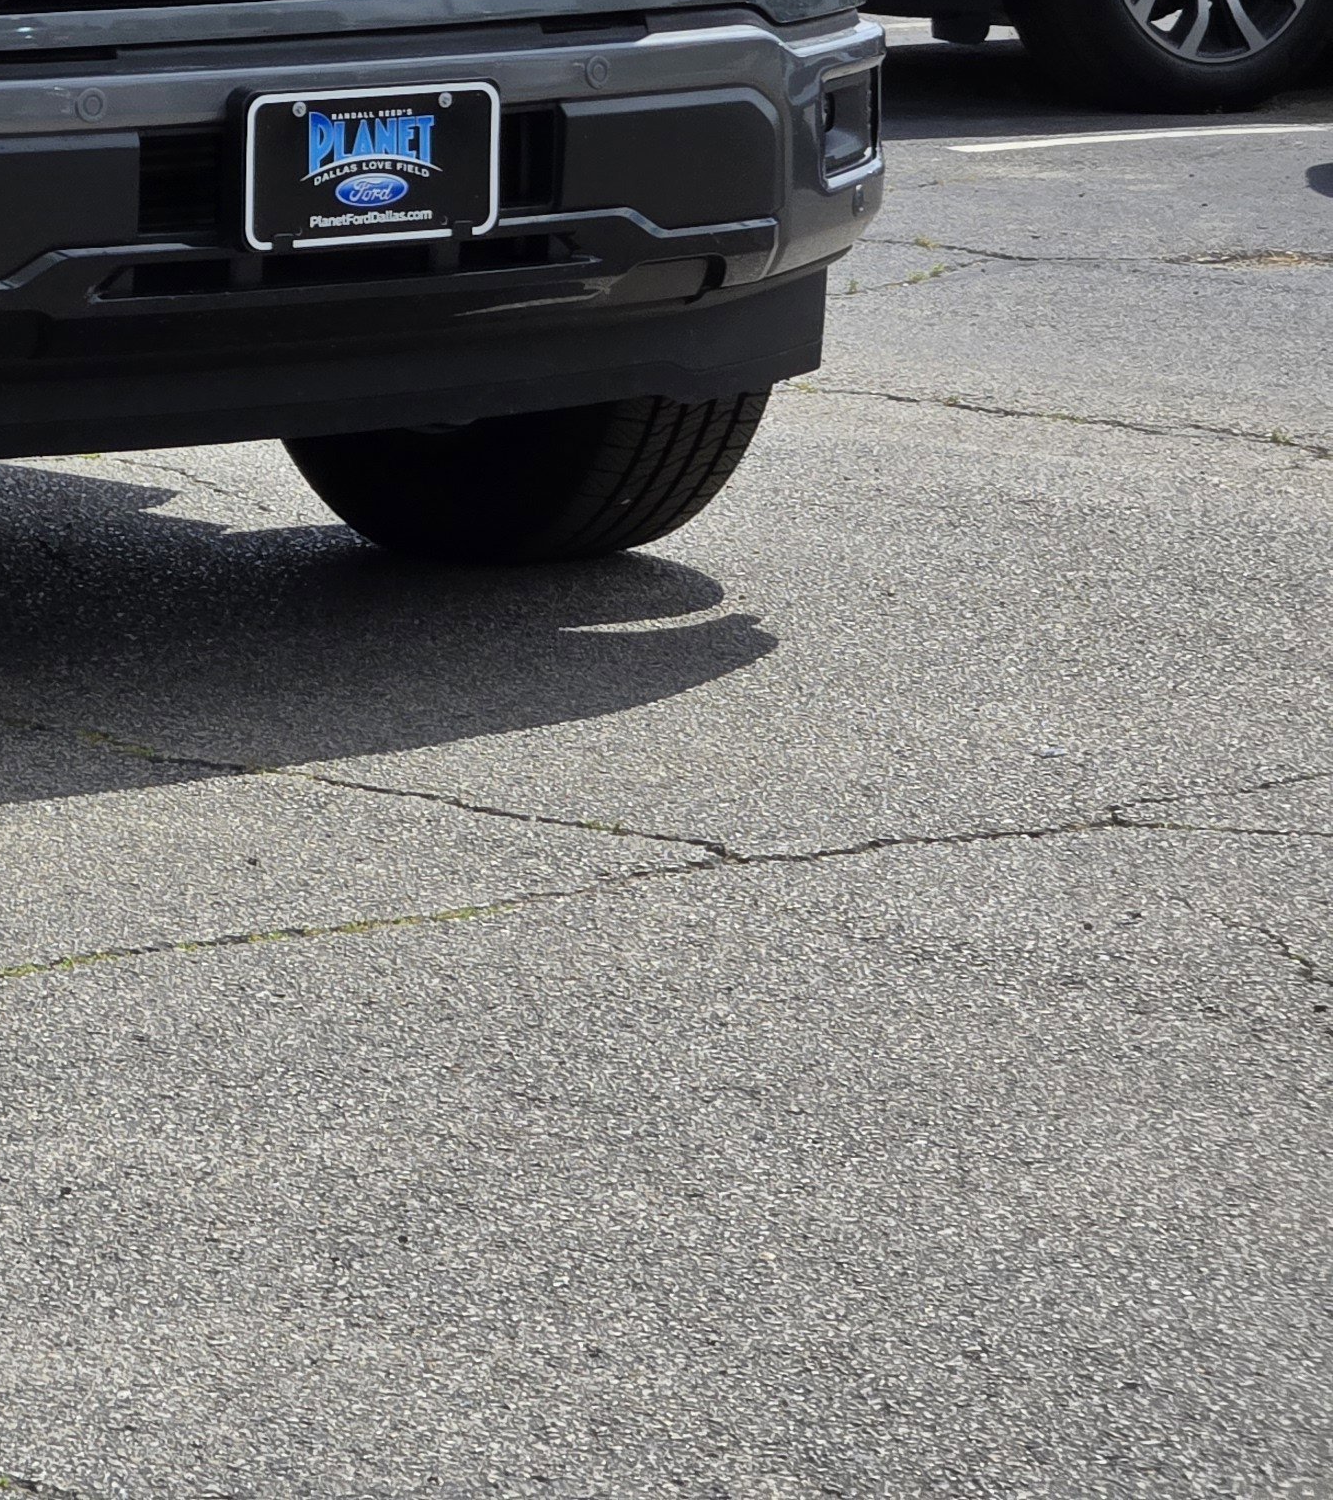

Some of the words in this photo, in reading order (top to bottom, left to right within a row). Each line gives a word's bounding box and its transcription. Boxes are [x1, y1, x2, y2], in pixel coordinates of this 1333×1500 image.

[308, 111, 435, 175] PLANET
[313, 164, 358, 186] DALLAS
[362, 161, 392, 171] LOVE
[396, 162, 430, 178] FIELD
[349, 180, 393, 202] Ford
[309, 209, 433, 228] PlanetFordDallas.com
